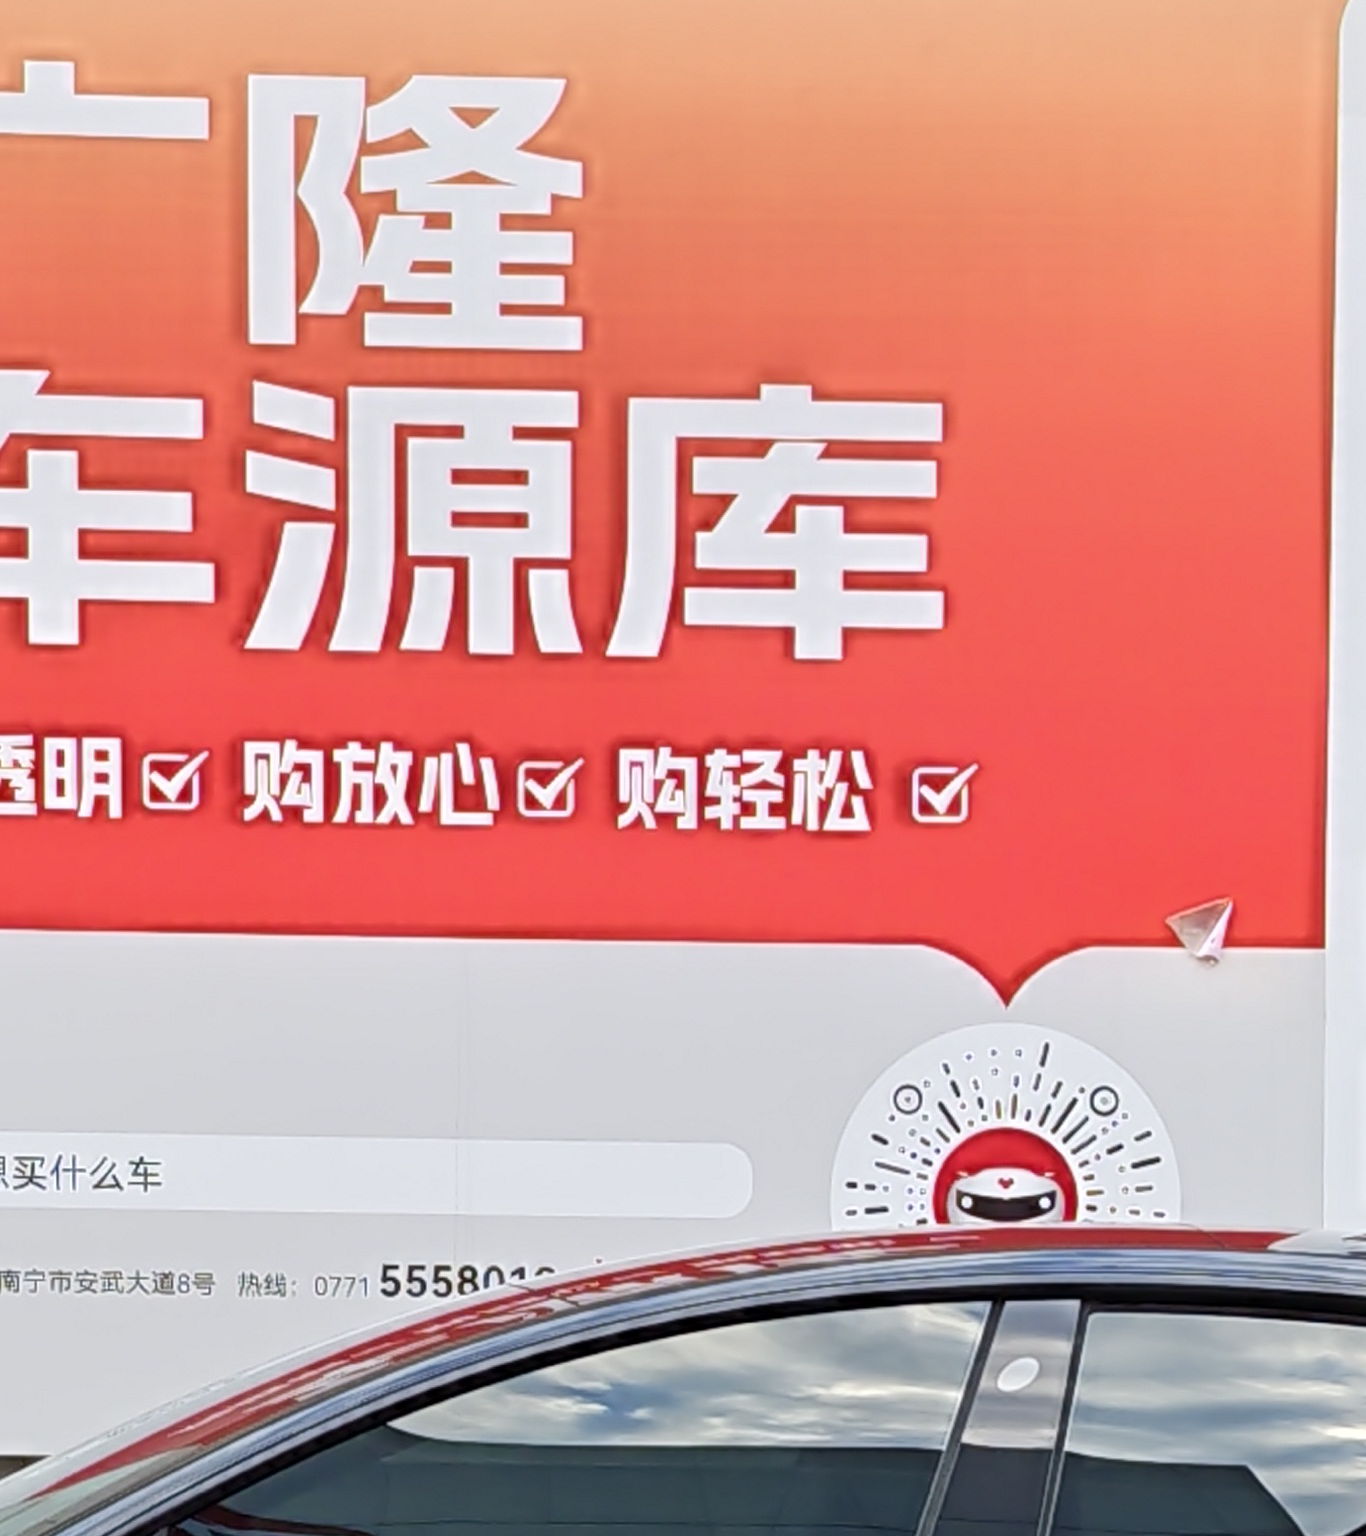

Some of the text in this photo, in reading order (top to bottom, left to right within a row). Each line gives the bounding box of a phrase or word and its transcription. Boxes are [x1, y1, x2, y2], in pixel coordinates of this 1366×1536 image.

[241, 739, 501, 829] 购放心
[617, 747, 874, 832] 购轻松
[380, 1264, 555, 1297] 55580
